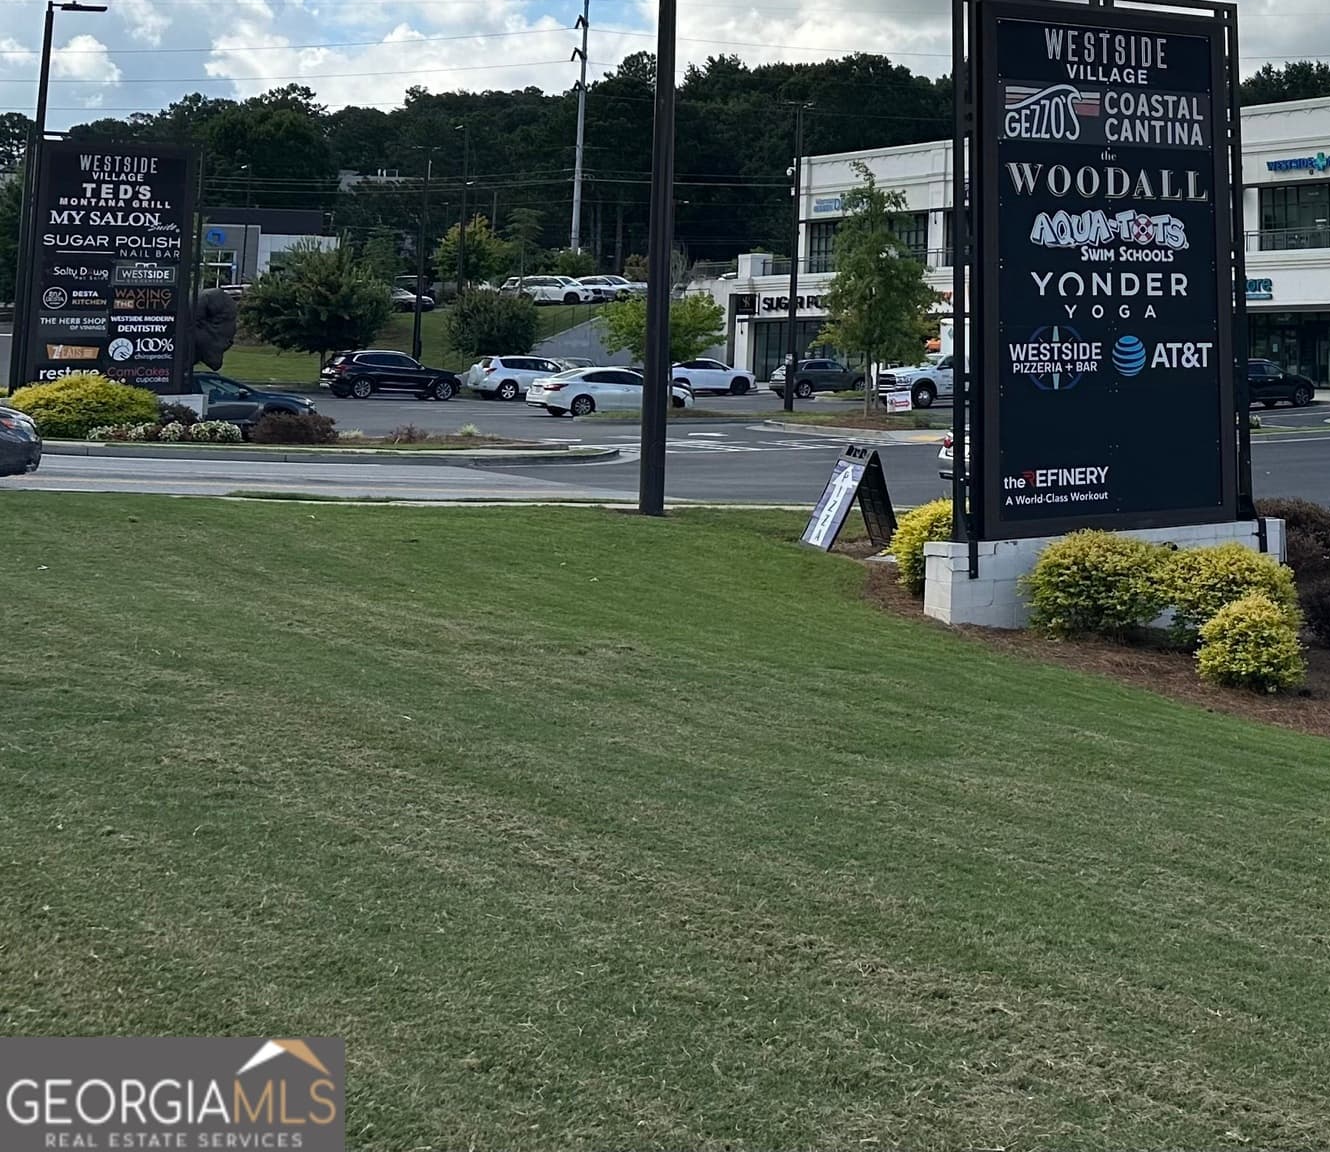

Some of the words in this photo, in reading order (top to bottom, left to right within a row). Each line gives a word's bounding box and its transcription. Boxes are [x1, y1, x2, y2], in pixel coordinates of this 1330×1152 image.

[1045, 28, 1168, 70] WESTSIDE
[1066, 64, 1149, 85] VILLAGE
[1104, 91, 1204, 121] COASTAL
[1004, 93, 1081, 141] GEZZO'S
[1105, 118, 1203, 146] CANTINA
[1101, 151, 1117, 161] the
[80, 154, 158, 174] WESTSIDE
[92, 171, 145, 182] VILLAGE
[1005, 162, 1209, 202] WOODALL
[82, 183, 152, 199] TED'S
[59, 198, 125, 207] MONTANA
[132, 201, 171, 209] GRILL
[50, 210, 86, 225] MY
[89, 212, 160, 227] SALON
[1030, 209, 1188, 249] AQUA-TOTS
[43, 234, 109, 247] SUGAR
[115, 236, 181, 249] POLISH
[119, 249, 151, 258] NAIL
[155, 250, 180, 259] BAR
[122, 269, 170, 279] WESTSIDE
[1031, 271, 1188, 297] YONDER
[115, 288, 171, 299] WAXING
[136, 299, 171, 309] CITY
[762, 296, 805, 311] SUGR
[1064, 304, 1157, 319] YOGA
[40, 317, 57, 325] THE
[59, 317, 81, 325] HERB
[82, 317, 107, 325] SHOP
[117, 324, 168, 333] DENTISTRY
[135, 337, 174, 352] 100%
[1009, 342, 1103, 362] WESTSIDE
[1151, 342, 1213, 369] AT&T
[1013, 361, 1063, 374] PIZZERIA
[1076, 361, 1098, 373] BAR
[1005, 495, 1013, 506] A
[1015, 492, 1069, 505] World-Class
[1070, 490, 1109, 502] Workout
